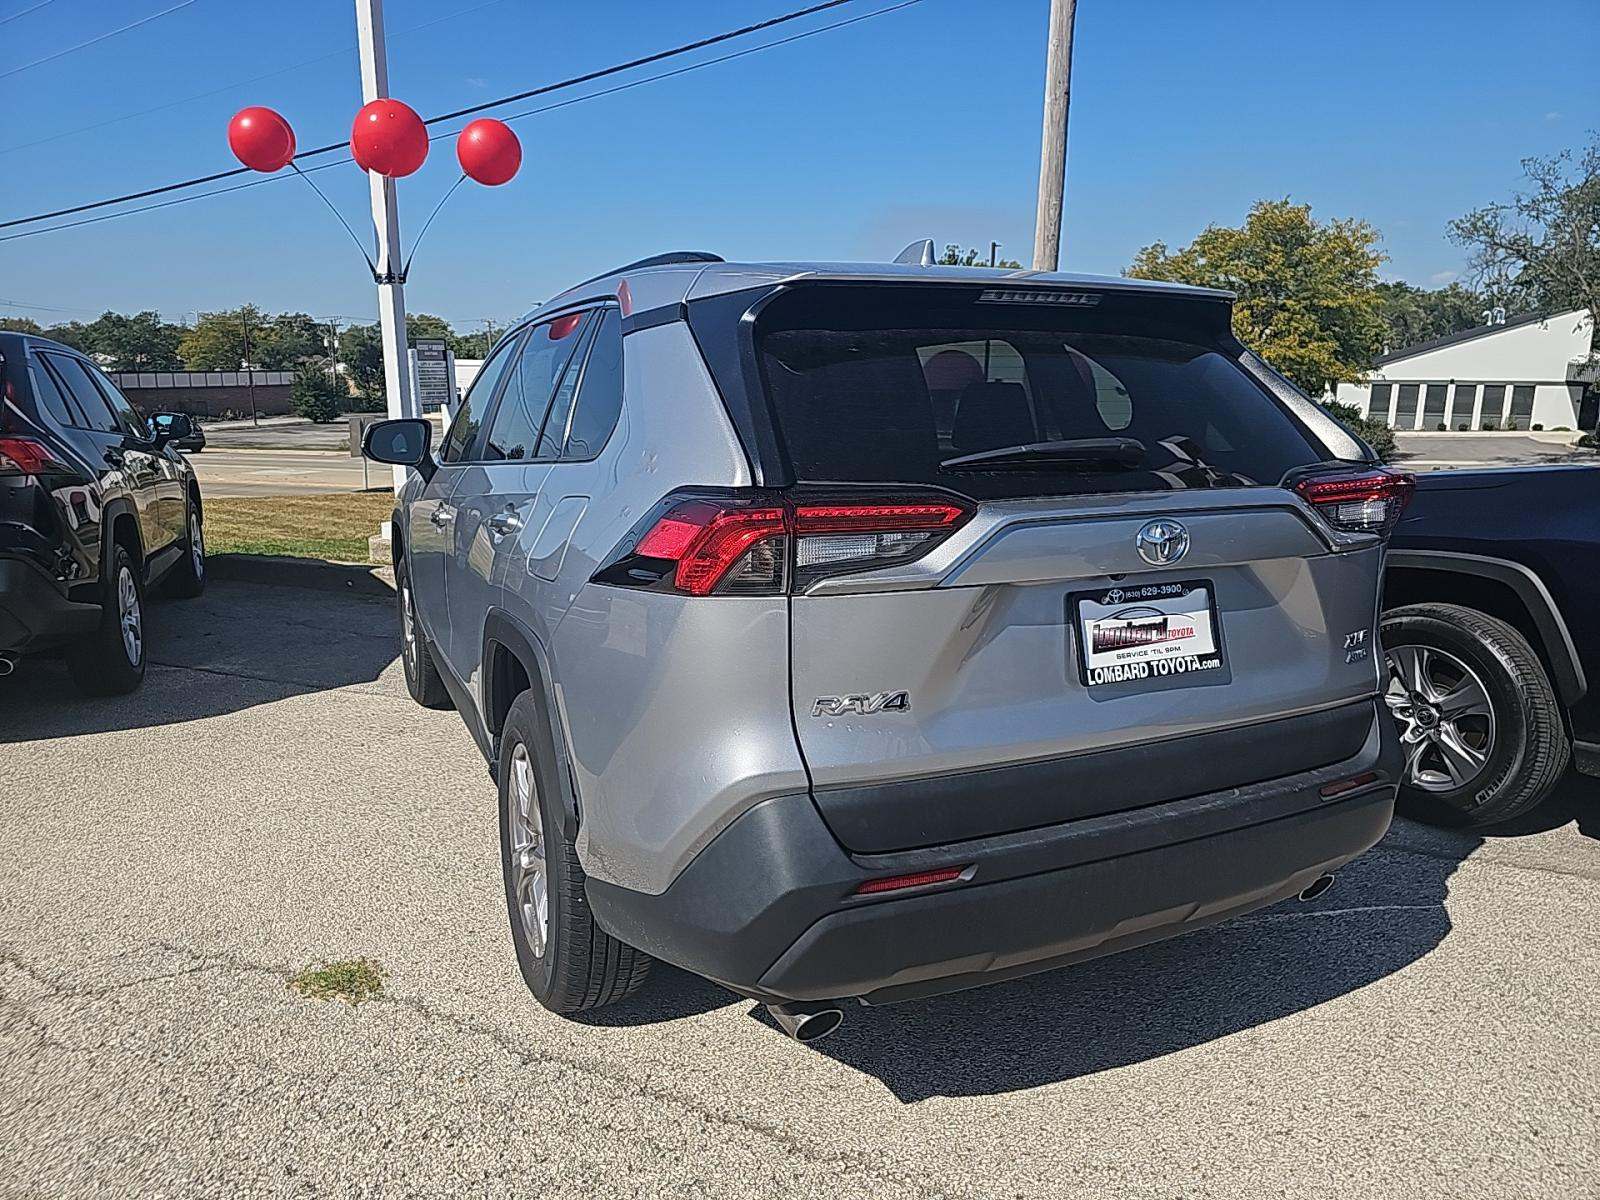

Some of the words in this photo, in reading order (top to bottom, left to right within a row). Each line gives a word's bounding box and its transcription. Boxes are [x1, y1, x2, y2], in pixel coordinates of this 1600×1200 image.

[1141, 584, 1181, 596] 629-3900
[1167, 627, 1194, 638] TOYOTA
[1116, 650, 1148, 660] SERVICE
[1087, 661, 1149, 685] LOMBARD
[1150, 656, 1220, 677] TOYOTA.com
[811, 689, 911, 718] RAV4
